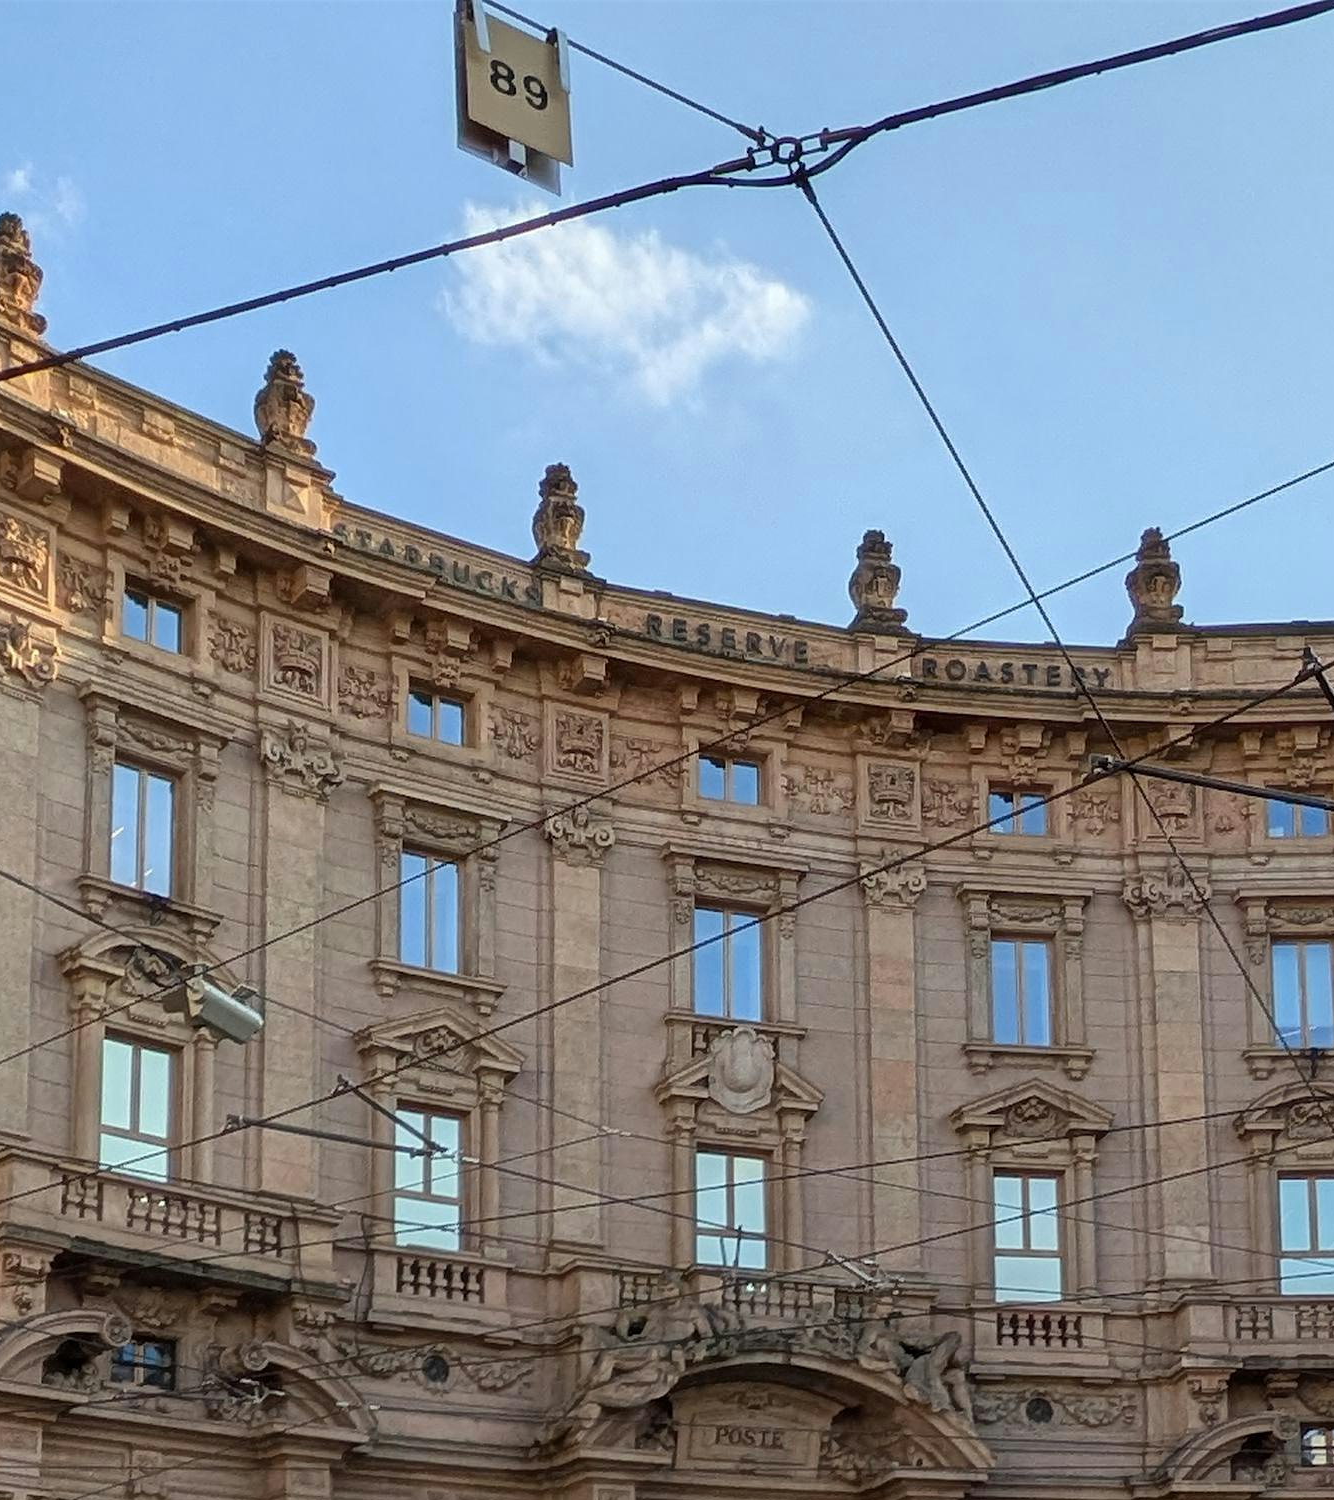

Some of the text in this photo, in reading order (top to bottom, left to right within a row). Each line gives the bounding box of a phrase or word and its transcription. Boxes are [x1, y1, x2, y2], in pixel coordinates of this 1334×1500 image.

[490, 59, 548, 111] 89
[333, 522, 1110, 688] STARBUCKS RESERVE ROASTERY
[715, 1425, 784, 1450] POSTE
